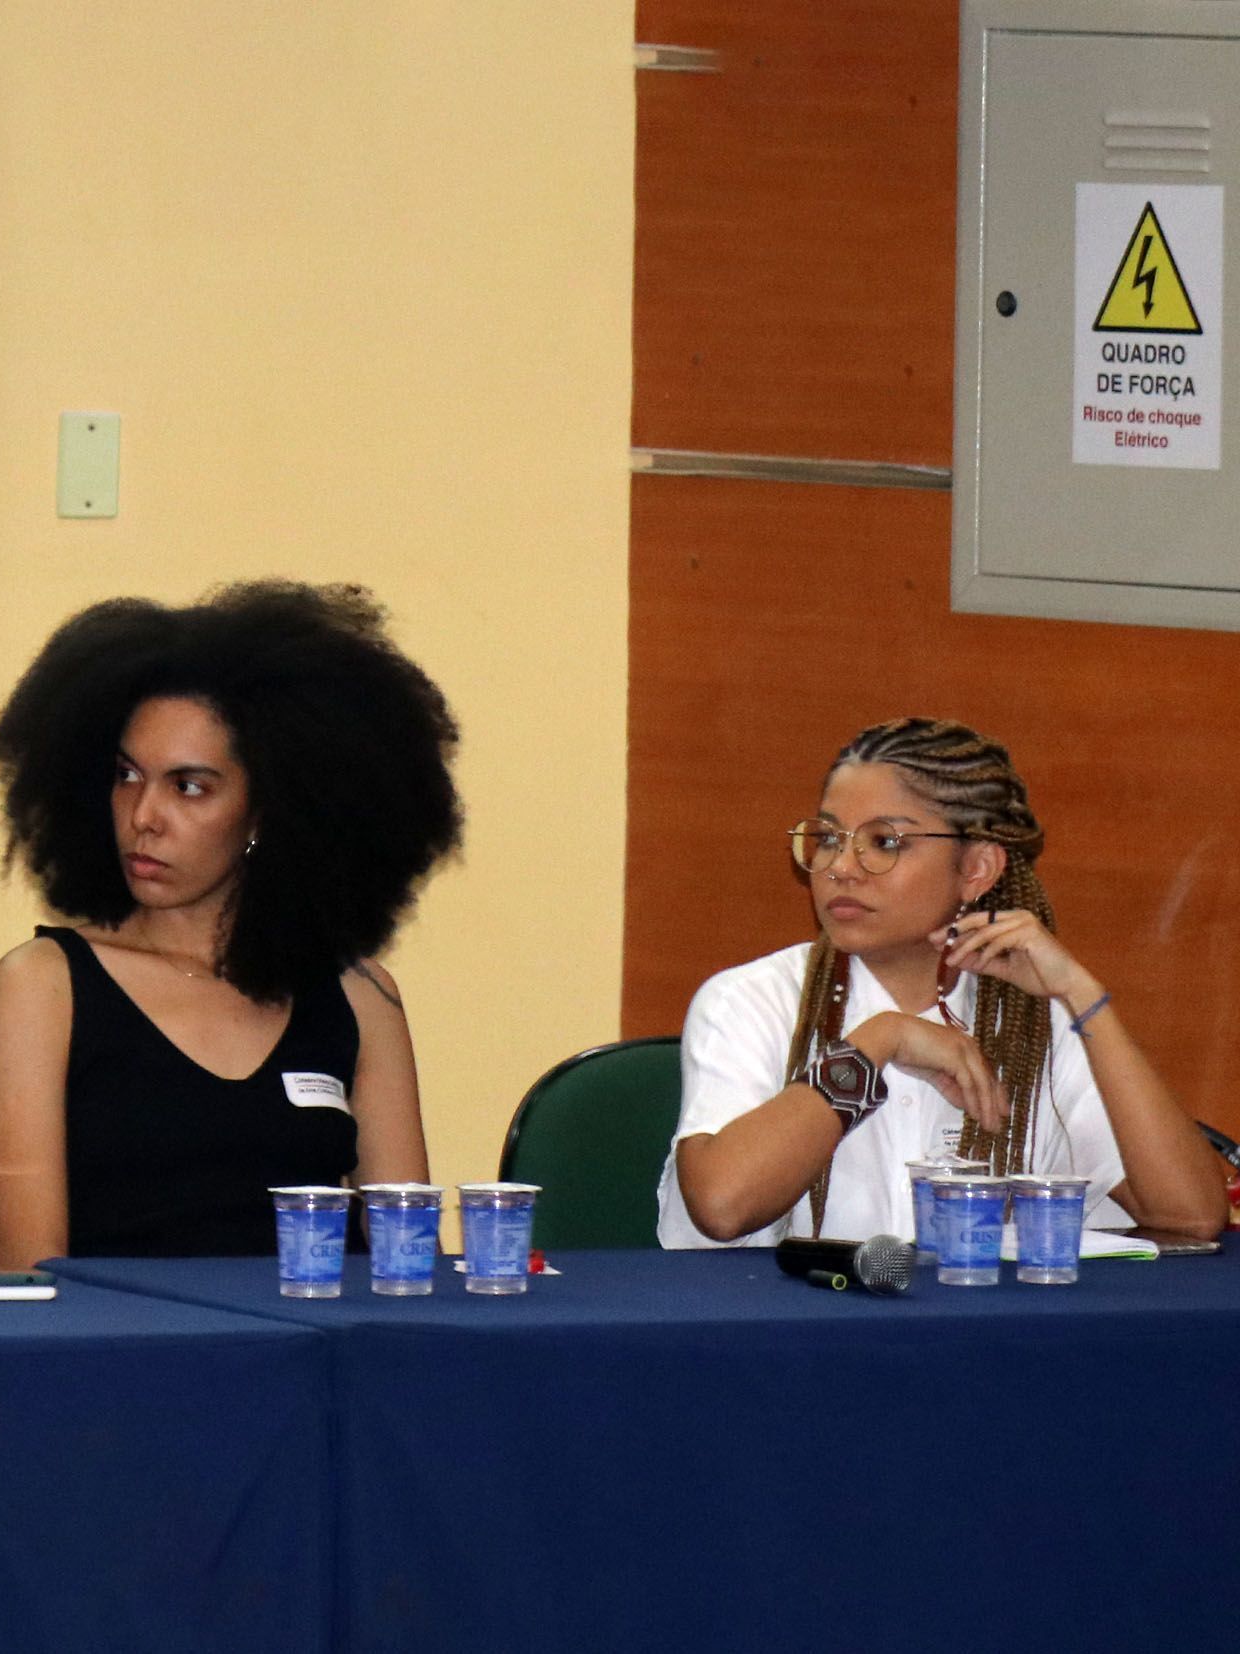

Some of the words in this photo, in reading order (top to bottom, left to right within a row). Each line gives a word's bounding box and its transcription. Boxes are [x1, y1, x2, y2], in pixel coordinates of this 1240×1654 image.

[1102, 343, 1185, 364] QUADRO
[1097, 374, 1123, 394] DE
[1128, 376, 1196, 401] FORÇA
[1083, 406, 1123, 423] Risco
[1126, 407, 1145, 424] de
[1148, 410, 1201, 428] choque
[1114, 431, 1169, 449] Elétrico
